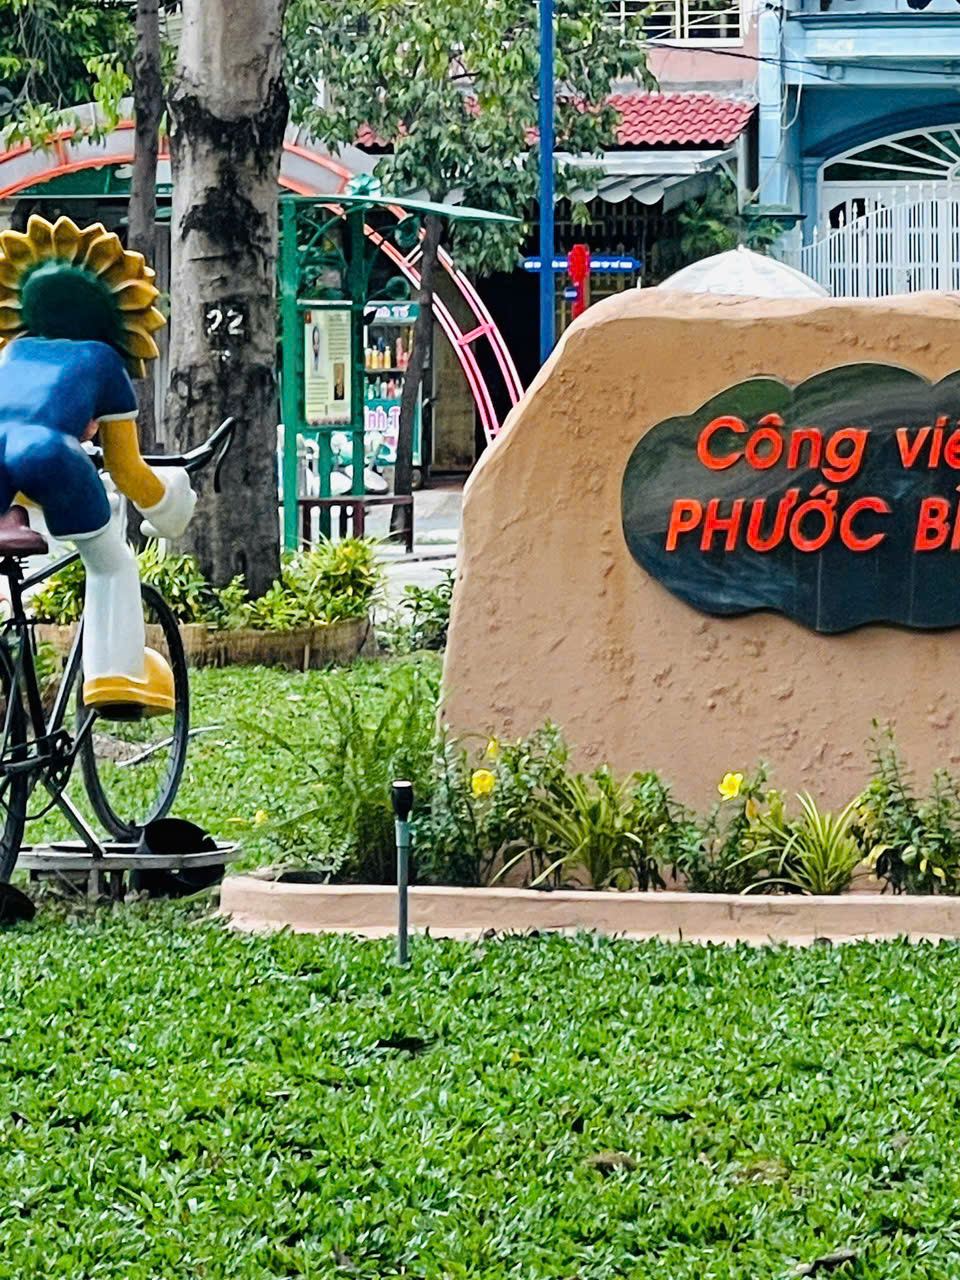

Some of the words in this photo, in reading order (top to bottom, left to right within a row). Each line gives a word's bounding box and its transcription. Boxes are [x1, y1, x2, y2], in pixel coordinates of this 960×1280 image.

[206, 308, 245, 336] 22
[696, 413, 870, 484] Công
[664, 483, 893, 553] PHƯỚC
